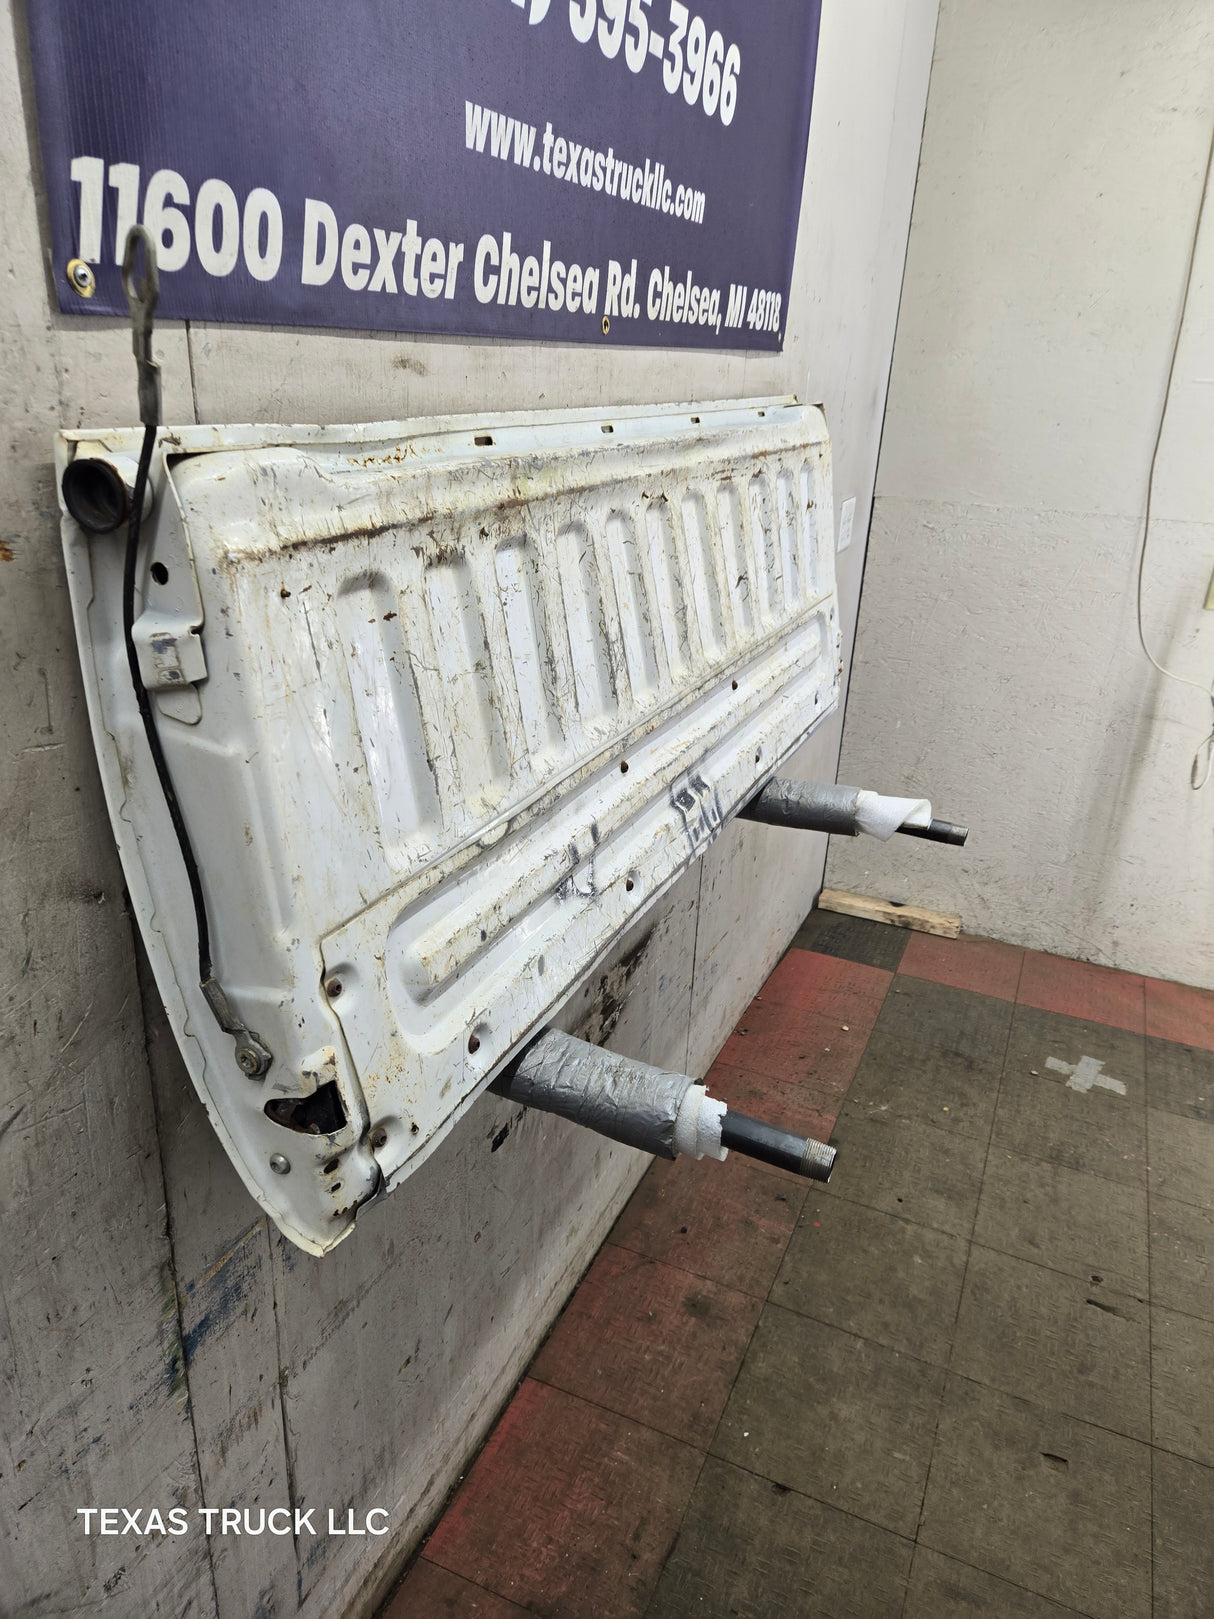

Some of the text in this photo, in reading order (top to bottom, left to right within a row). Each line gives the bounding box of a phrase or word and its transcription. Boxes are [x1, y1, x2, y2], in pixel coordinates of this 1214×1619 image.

[465, 100, 706, 224] www.texastruckllc.com
[70, 156, 782, 335] 11600 Dexter Chelsea Rd. Chelsea, MI 48118
